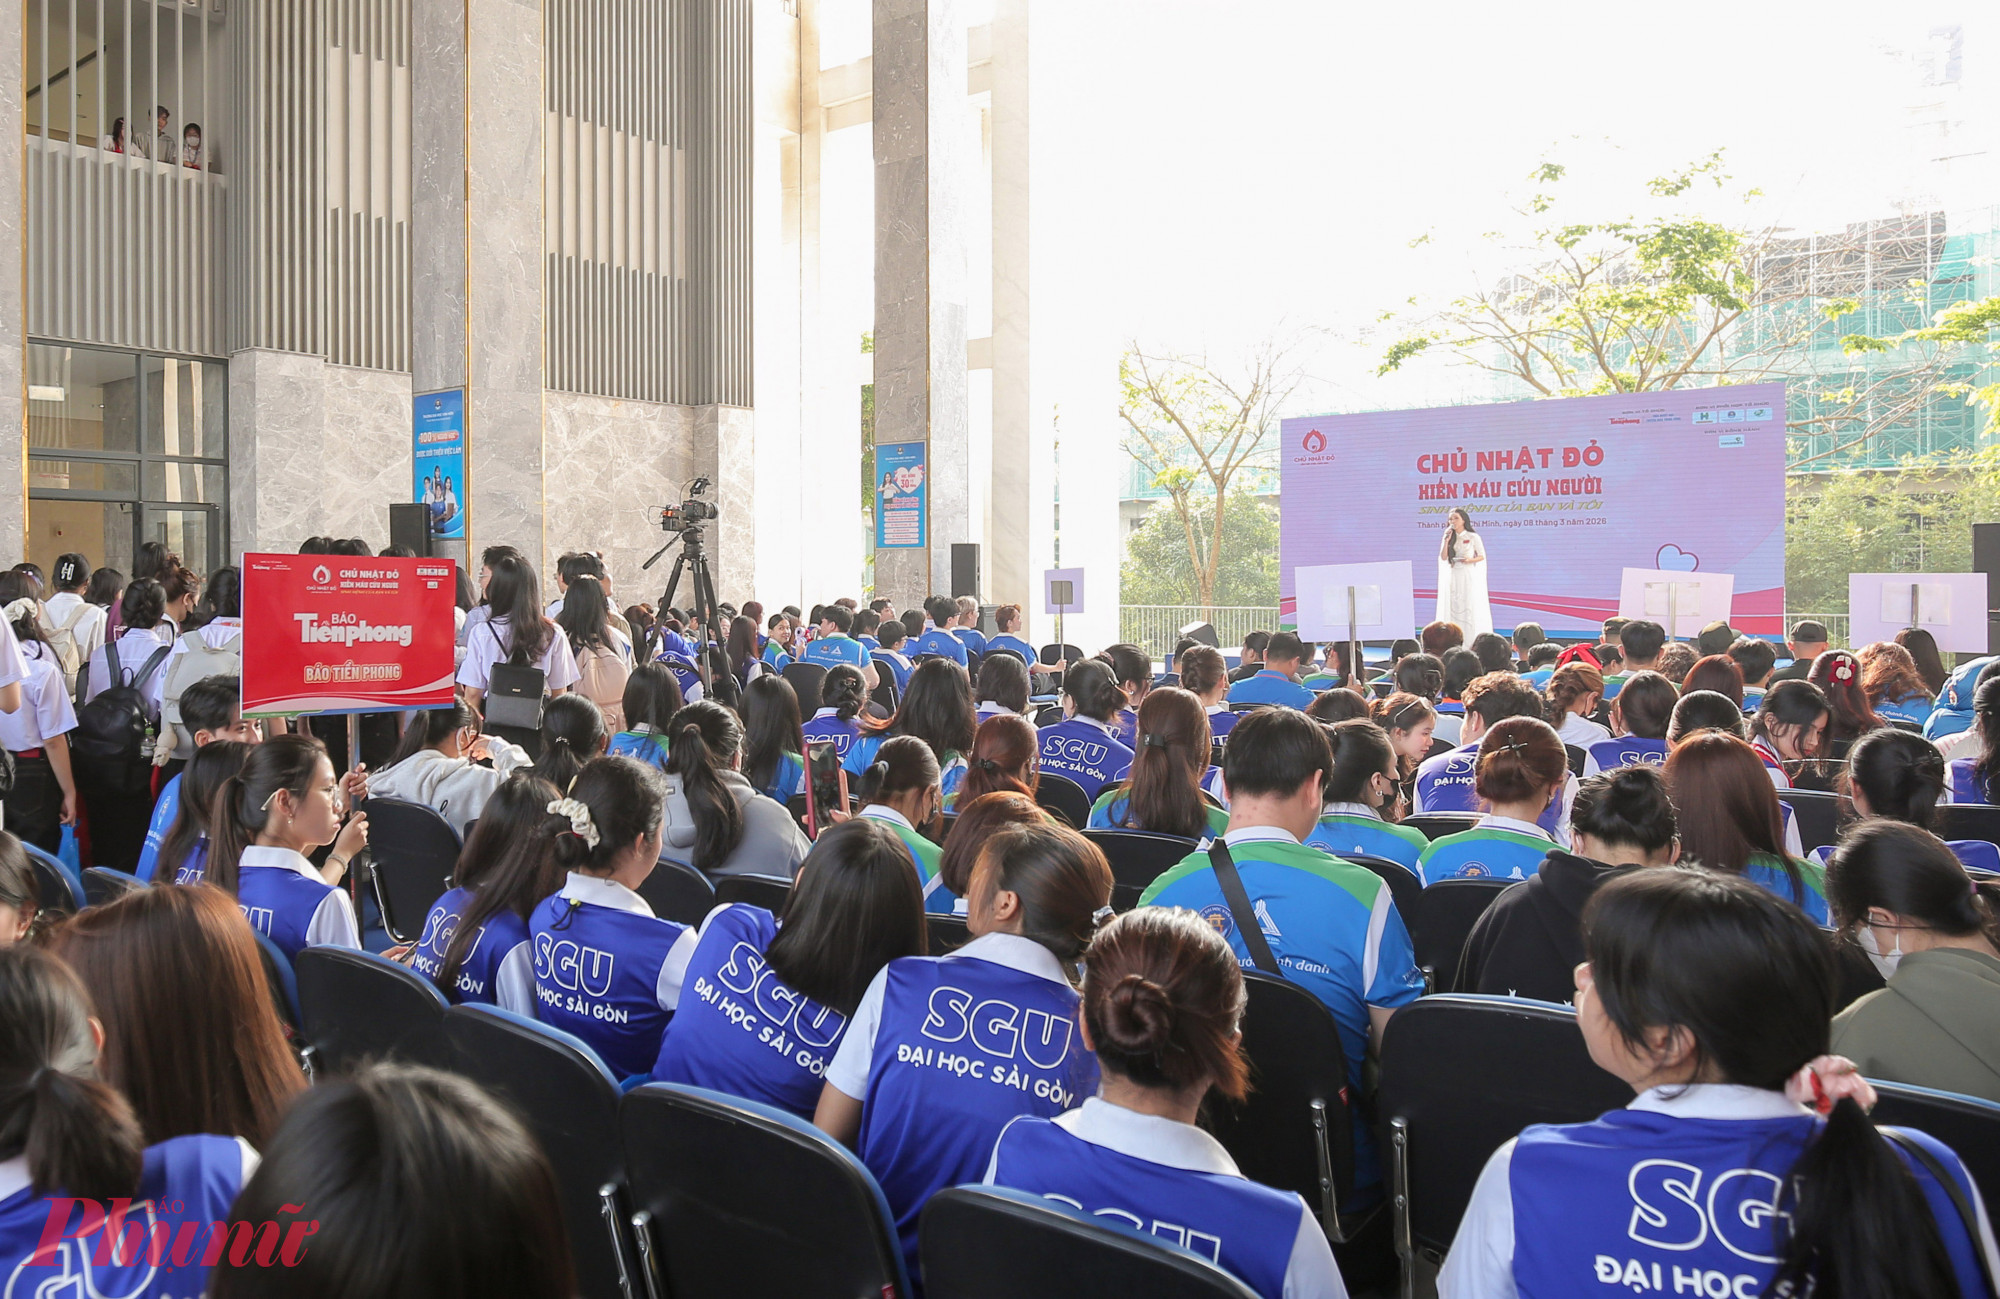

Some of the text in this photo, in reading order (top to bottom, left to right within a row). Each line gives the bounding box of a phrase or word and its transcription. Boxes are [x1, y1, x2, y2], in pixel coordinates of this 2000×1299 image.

[1416, 439, 1604, 474] CHỦ NHẬT ĐỎ
[1418, 474, 1602, 500] HIẾN MÁU CỨU NGƯỜI
[1494, 501, 1523, 512] CỦA
[1525, 503, 1556, 514] BẠN
[1557, 500, 1575, 511] VÀ
[1578, 499, 1604, 510] TÔI
[1418, 521, 1440, 529] Thành
[1503, 520, 1522, 529] ngày
[1535, 519, 1558, 528] tháng
[340, 568, 400, 580] CHỦ NHẬT ĐỎ
[331, 611, 356, 624] BÁO
[305, 664, 330, 682] BÁO
[362, 665, 401, 680] PHONG
[1042, 735, 1108, 765] SGU
[1047, 758, 1068, 769] HỌC
[1068, 762, 1084, 773] SÀI
[1086, 767, 1107, 782] GÒN
[1434, 776, 1476, 787] ĐẠI HỌ
[415, 954, 433, 973] HỌC
[535, 932, 614, 997] SGU
[1295, 959, 1330, 975] danh
[540, 987, 628, 1024] HỌC SÀI GÒN
[717, 941, 847, 1047] SGU
[694, 977, 721, 1005] ĐẠI
[718, 996, 757, 1032] HỌC
[758, 1026, 794, 1057] SÀI
[920, 986, 1074, 1070] SGU
[897, 1044, 1074, 1108] ĐẠI HỌC SÀI GÒN
[1628, 1158, 1800, 1264] SG
[1593, 1254, 1664, 1294] ĐẠI
